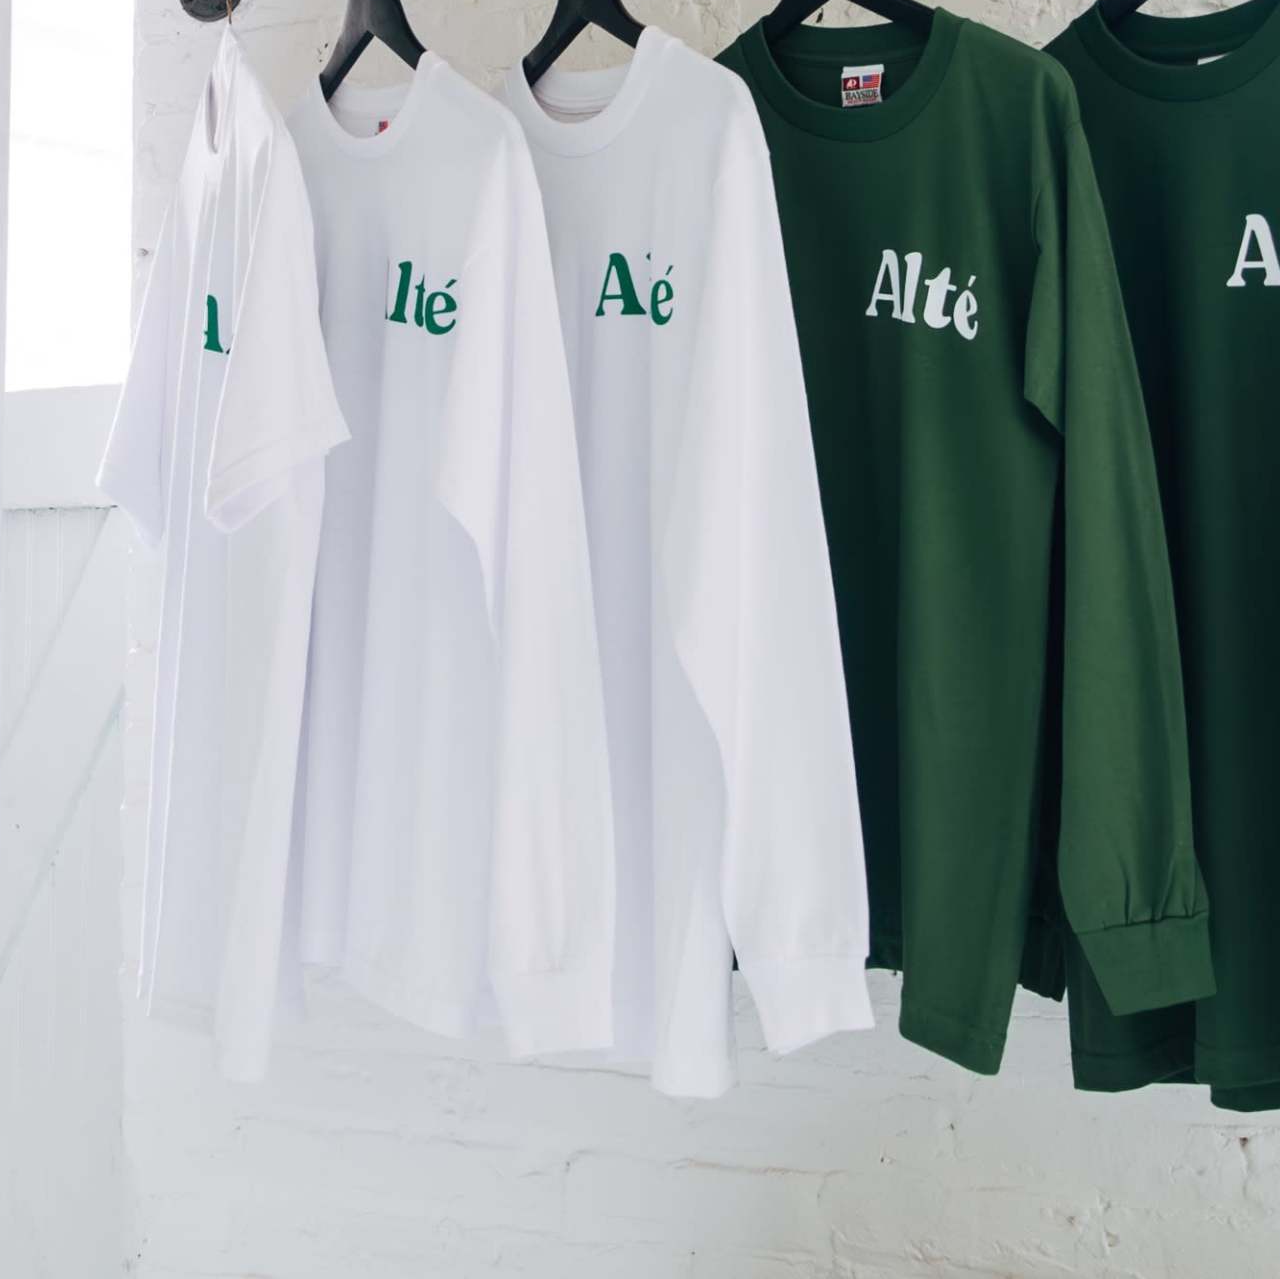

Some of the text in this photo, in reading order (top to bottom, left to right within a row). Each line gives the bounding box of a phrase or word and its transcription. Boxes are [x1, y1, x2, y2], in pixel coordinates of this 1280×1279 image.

[385, 260, 459, 336] lté
[595, 252, 675, 327] Aé
[865, 249, 980, 341] Alté
